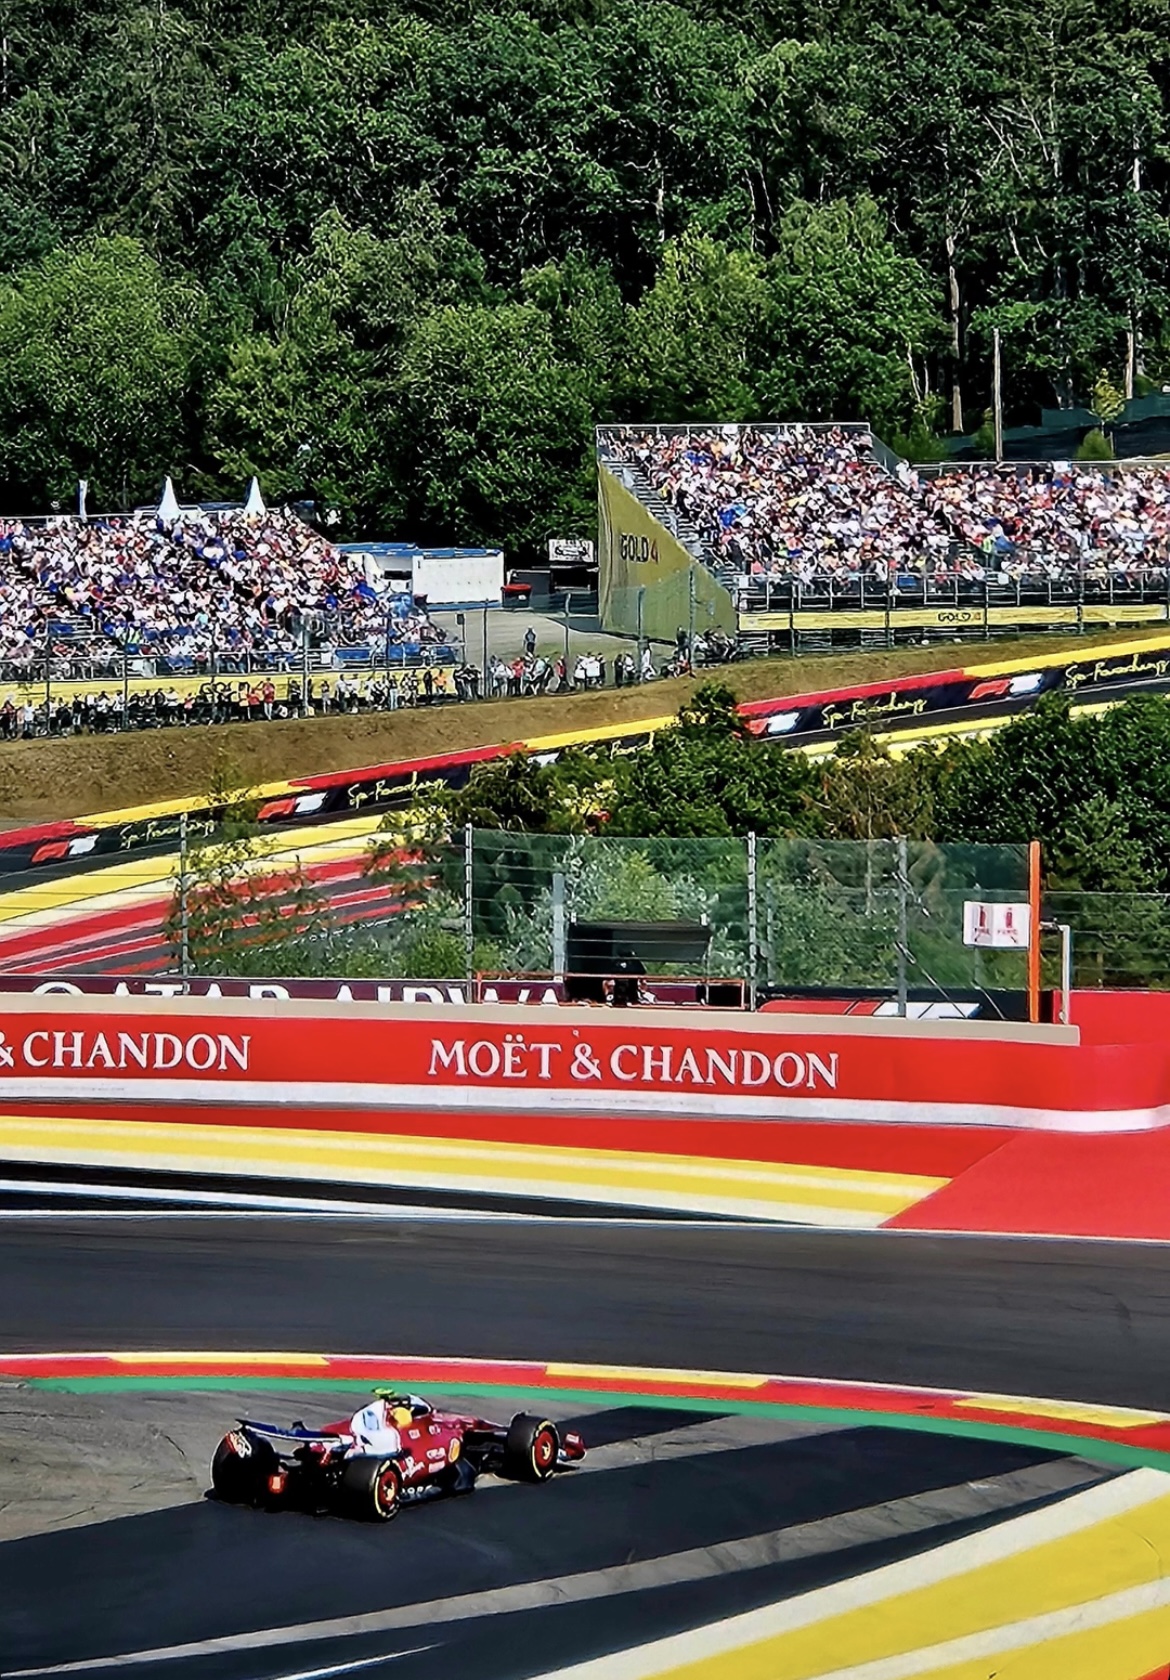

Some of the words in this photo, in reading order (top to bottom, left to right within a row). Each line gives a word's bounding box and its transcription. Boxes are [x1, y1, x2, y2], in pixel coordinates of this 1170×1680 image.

[620, 534, 649, 562] GOLD
[23, 1031, 250, 1071] CHANDON
[427, 1034, 562, 1079] MOËT
[570, 1043, 602, 1082] &
[610, 1045, 839, 1090] CHANDON
